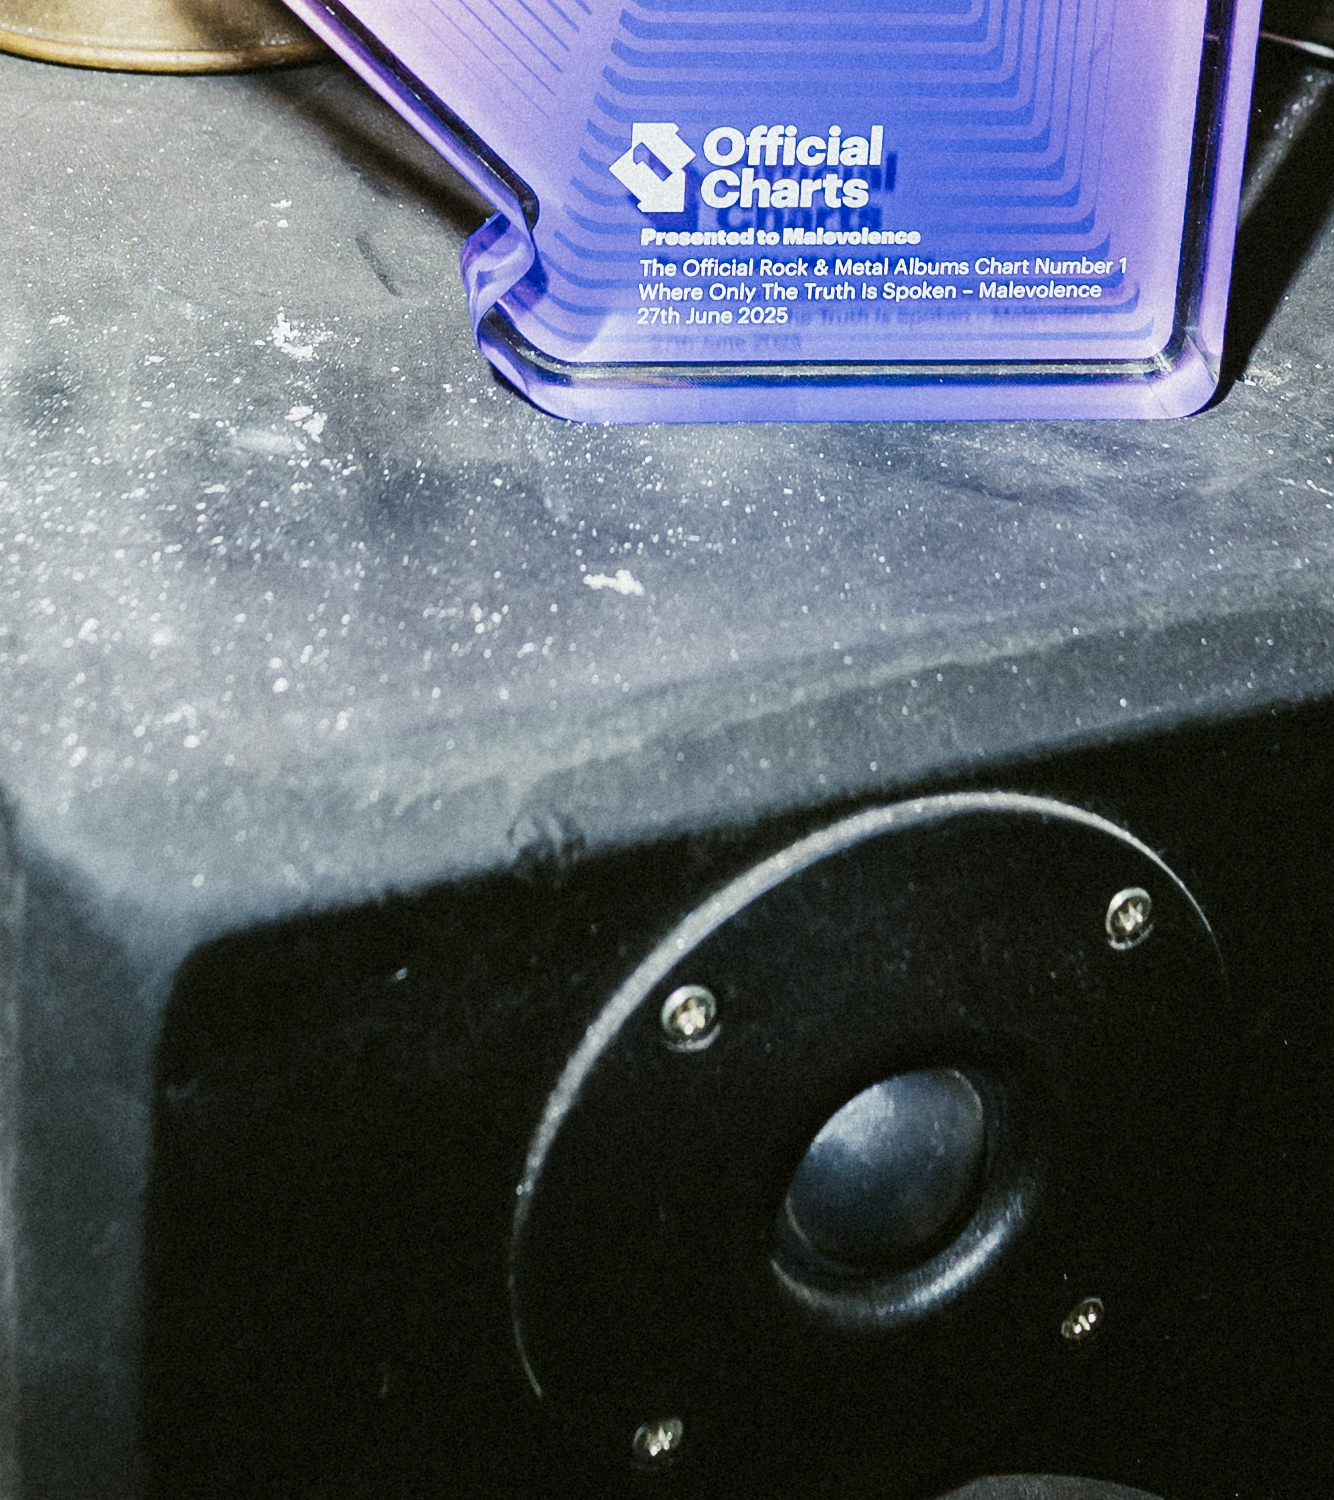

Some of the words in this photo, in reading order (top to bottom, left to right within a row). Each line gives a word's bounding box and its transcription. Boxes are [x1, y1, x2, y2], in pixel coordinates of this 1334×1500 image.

[703, 124, 884, 167] Official
[700, 167, 870, 209] Charts
[640, 227, 754, 246] Presented
[757, 229, 780, 245] to
[782, 226, 922, 245] Malevolence
[639, 258, 677, 277] The
[682, 257, 754, 277] Official
[760, 257, 809, 277] Rock
[813, 258, 829, 276] &
[834, 257, 889, 276] Metal
[893, 257, 970, 276] Albums
[974, 256, 1030, 275] Chart
[1034, 256, 1114, 275] Number
[1118, 256, 1128, 274] 1
[638, 282, 704, 301] Where
[708, 282, 757, 304] Only
[761, 281, 799, 300] The
[803, 281, 856, 300] Truth
[861, 282, 878, 300] Is
[882, 280, 957, 303] Spoken
[978, 280, 1103, 299] Malevolence
[636, 306, 680, 325] 27th
[685, 306, 733, 325] June
[737, 306, 789, 324] 2025
